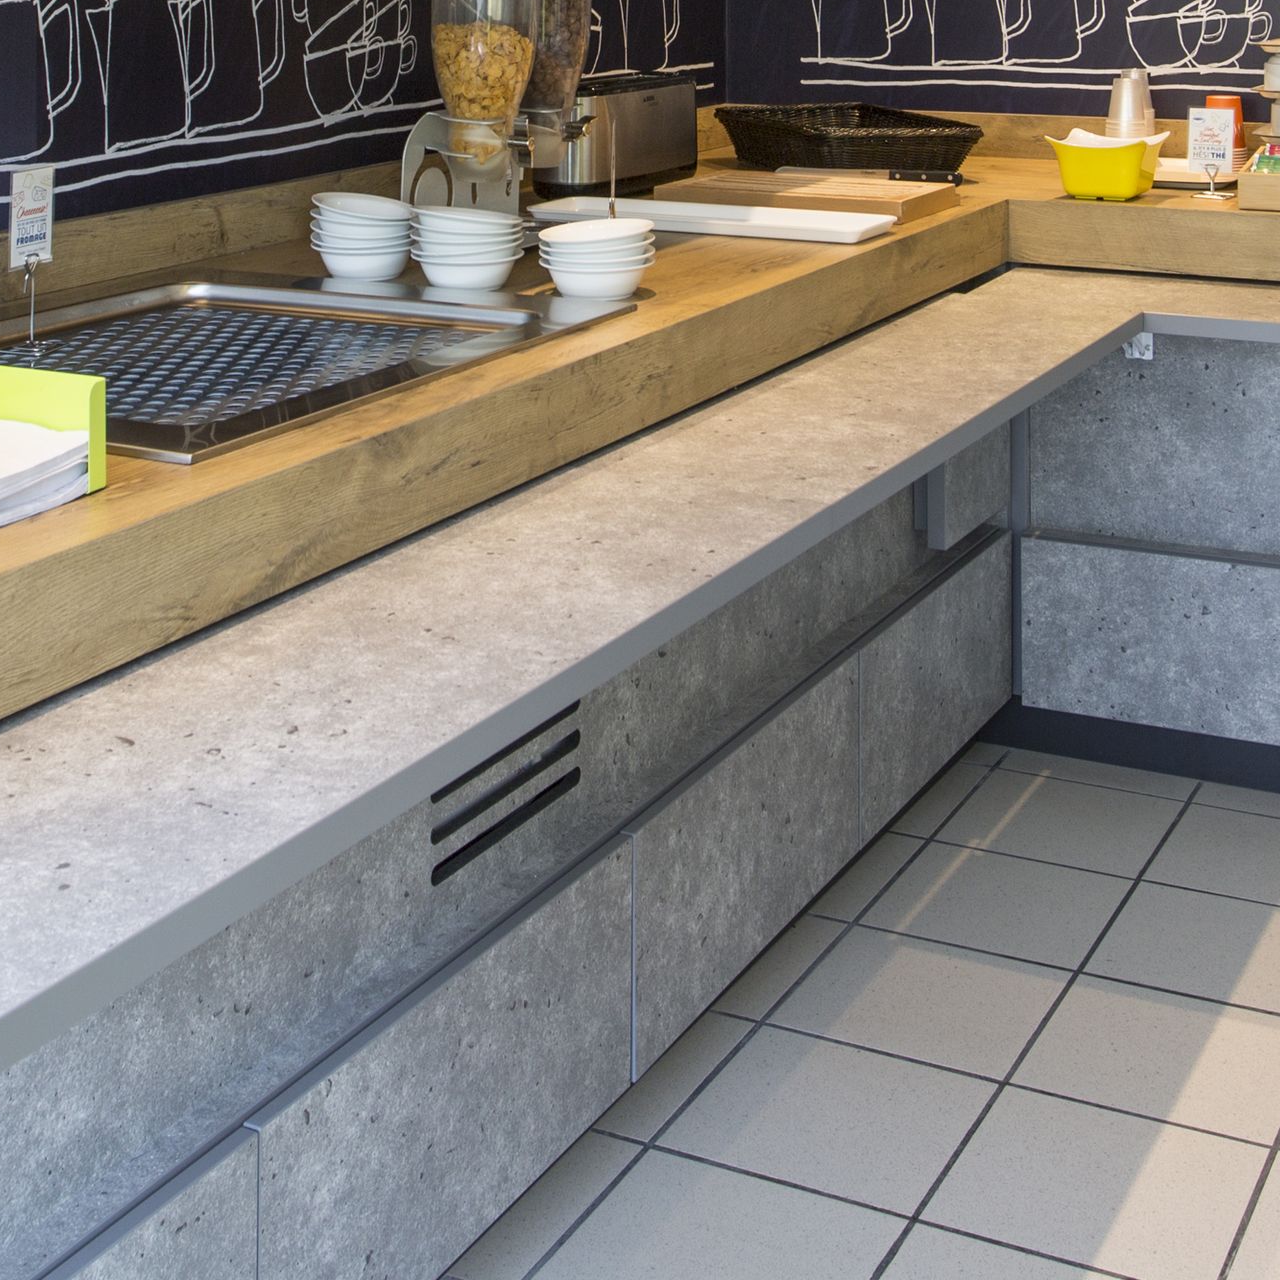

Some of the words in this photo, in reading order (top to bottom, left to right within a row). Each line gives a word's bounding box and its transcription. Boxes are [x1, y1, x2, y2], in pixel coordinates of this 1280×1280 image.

[17, 224, 36, 237] TOUT
[36, 222, 48, 233] UN
[16, 231, 47, 246] FROMAGE
